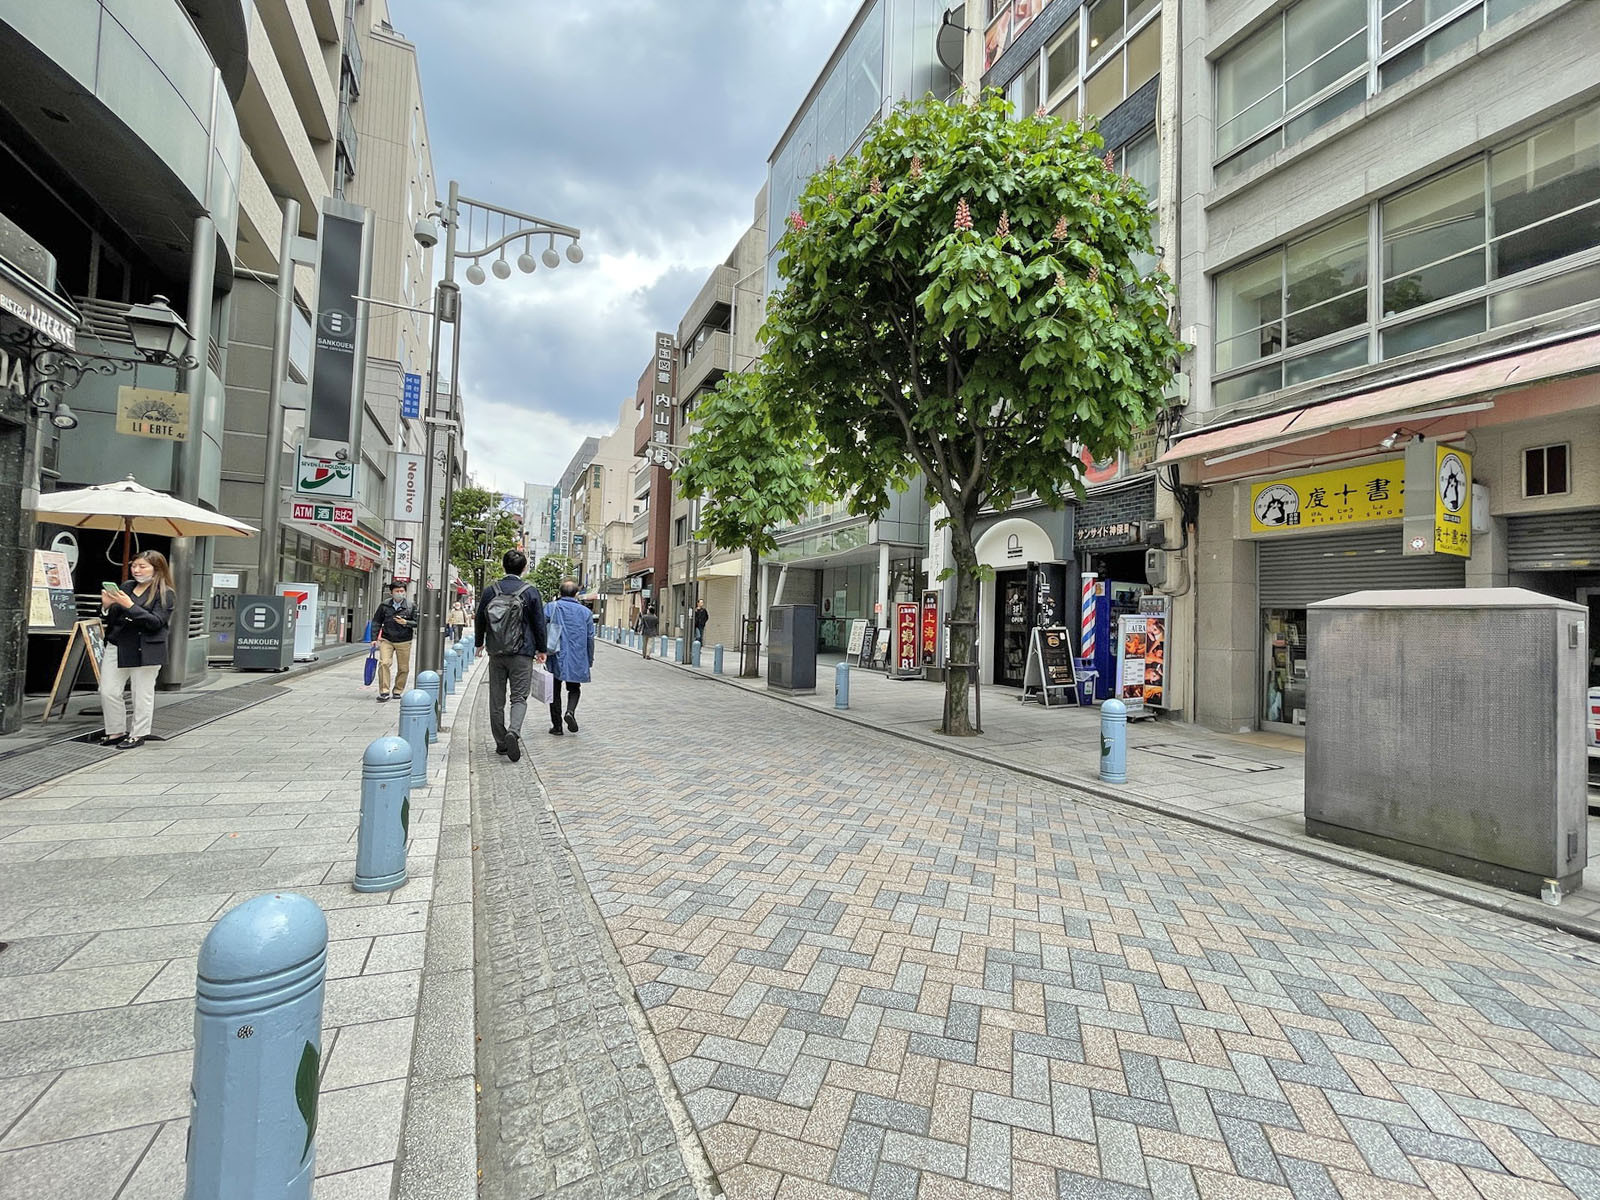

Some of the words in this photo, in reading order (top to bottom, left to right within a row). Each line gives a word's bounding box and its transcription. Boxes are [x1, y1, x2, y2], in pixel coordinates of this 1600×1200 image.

[317, 337, 355, 350] SANKOUEN
[404, 461, 417, 513] Neolive
[294, 507, 313, 518] ATM
[317, 508, 330, 519] 酒
[334, 508, 353, 521] たばこ
[237, 637, 280, 646] SANKOUEN
